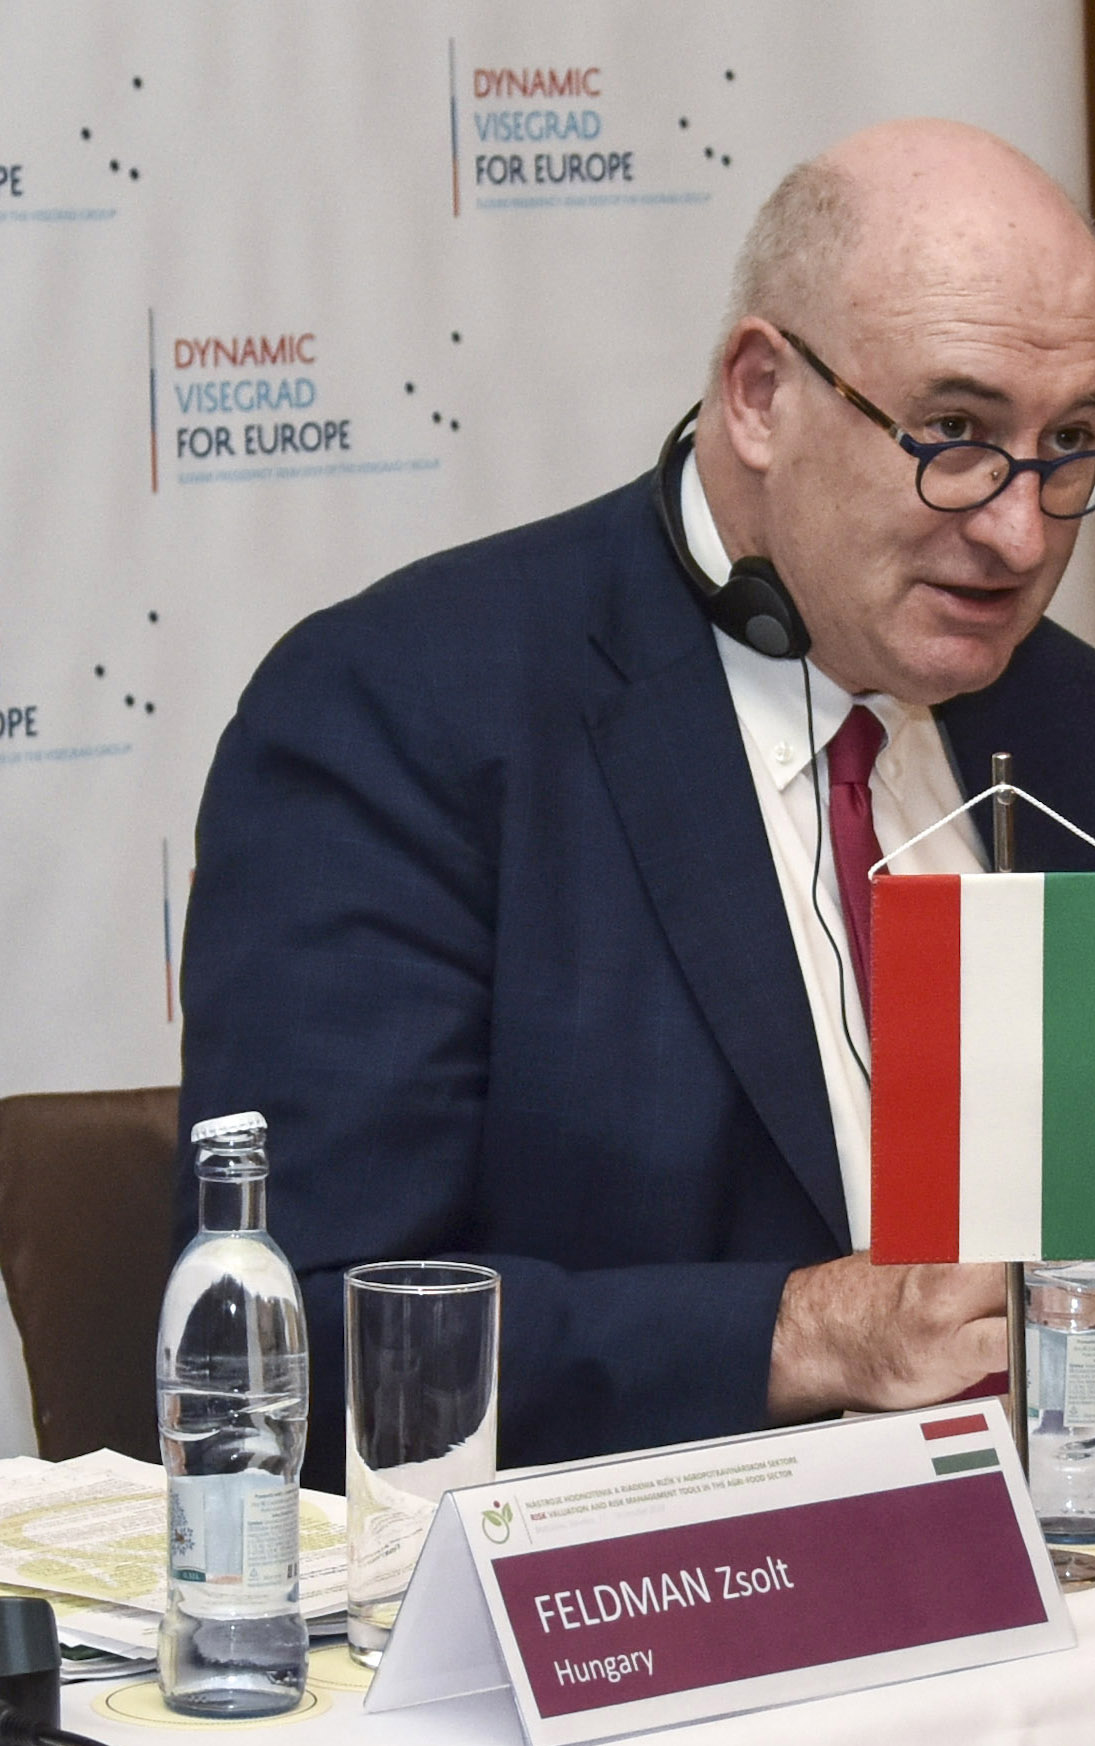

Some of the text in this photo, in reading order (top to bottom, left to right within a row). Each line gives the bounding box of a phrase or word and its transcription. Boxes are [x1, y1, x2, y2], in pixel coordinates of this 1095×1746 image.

[474, 68, 601, 98] DYNAMIC
[474, 111, 601, 142] VISEGRAD
[476, 152, 633, 185] FOR EUROPE
[174, 334, 315, 369] DYNAMIC
[175, 378, 316, 414] VISEGRAD
[177, 420, 351, 458] FOR EUROPE
[529, 1511, 547, 1520] RISK
[547, 1504, 588, 1517] VALUATION
[588, 1501, 607, 1510] AND
[607, 1498, 624, 1507] RISK
[624, 1489, 678, 1504] MANAGEMENT
[677, 1485, 701, 1495] TOOLS
[701, 1483, 711, 1491] IN
[711, 1481, 725, 1489] THE
[766, 1469, 793, 1480] SECTOR
[534, 1555, 795, 1634] FELDMAN Zsolt
[554, 1649, 654, 1686] Hungary
